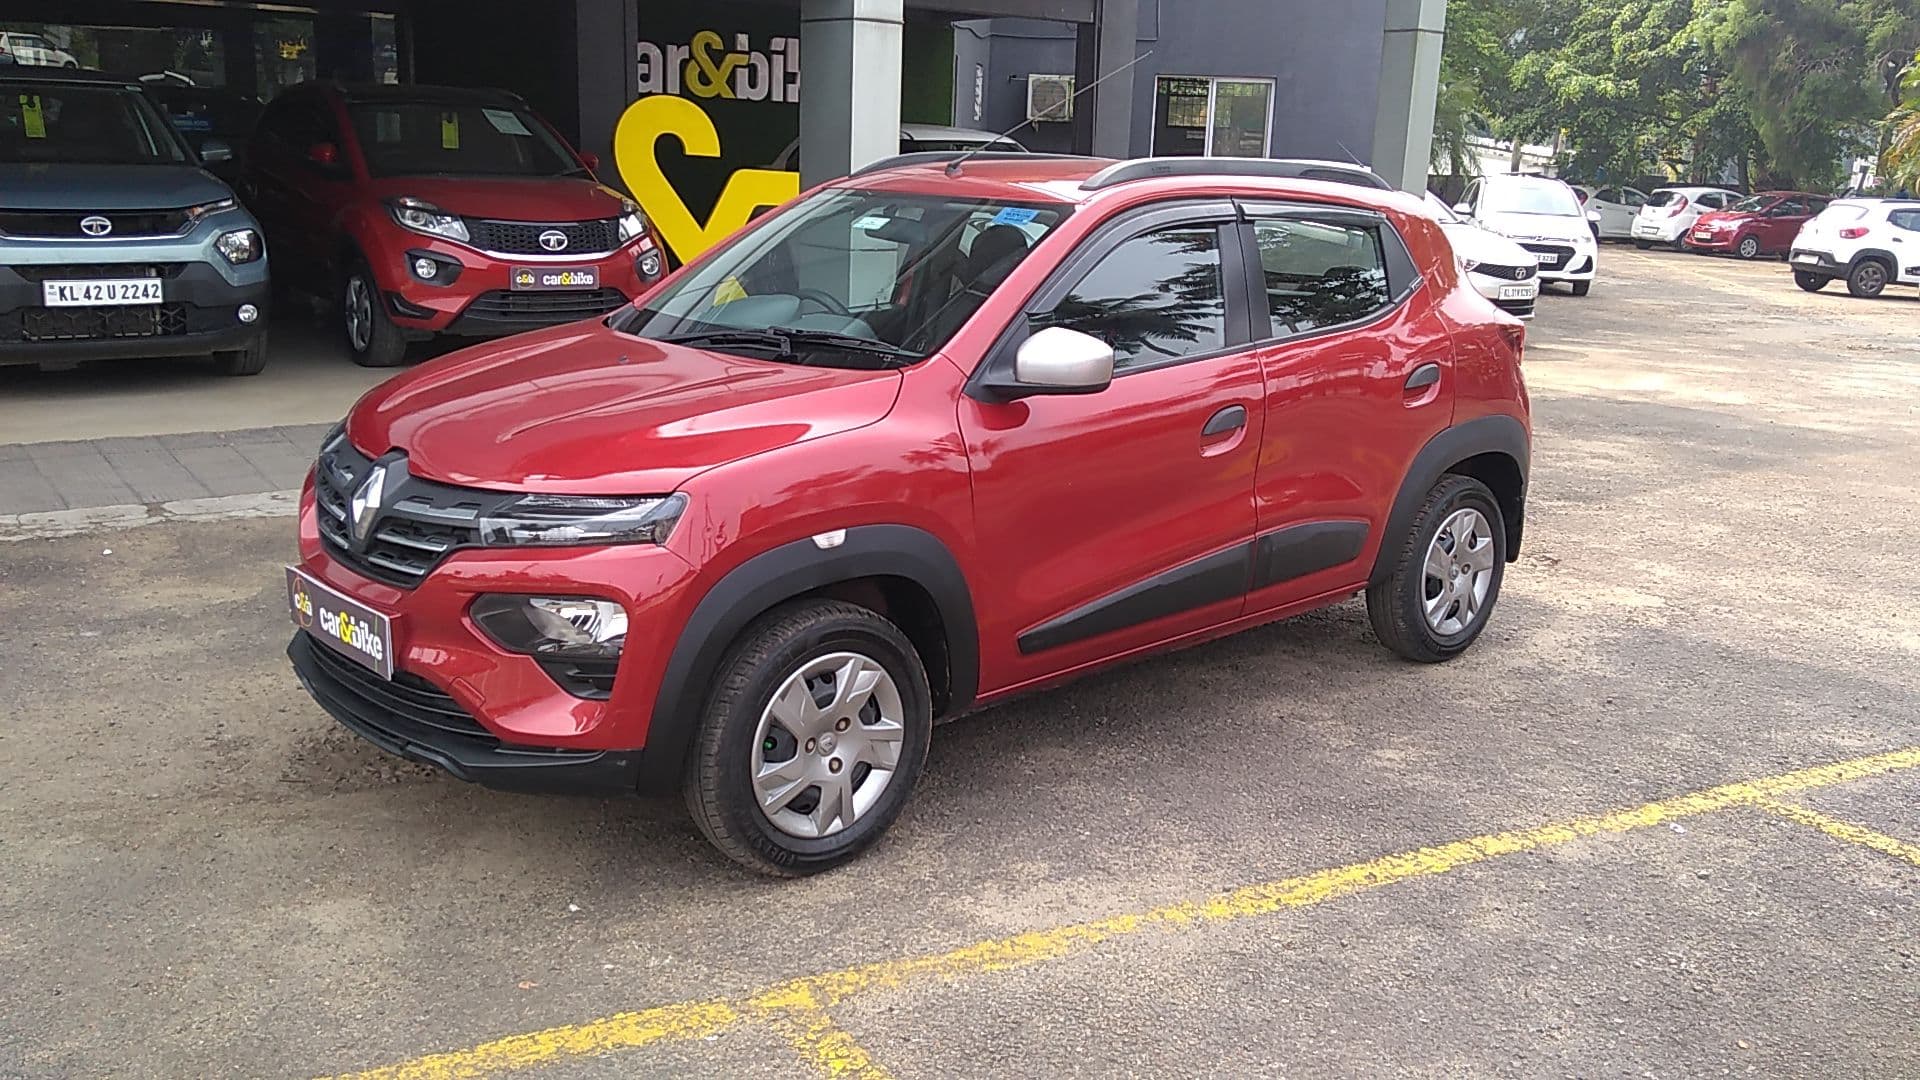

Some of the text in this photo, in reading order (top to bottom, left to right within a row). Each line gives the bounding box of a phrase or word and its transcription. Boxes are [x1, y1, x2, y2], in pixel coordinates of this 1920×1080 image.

[637, 30, 800, 103] ar&bi
[58, 285, 79, 302] KL
[83, 285, 103, 301] 42
[106, 284, 116, 300] U
[121, 283, 160, 300] 2242
[543, 272, 594, 285] car&bike
[320, 607, 383, 660] car&bike
